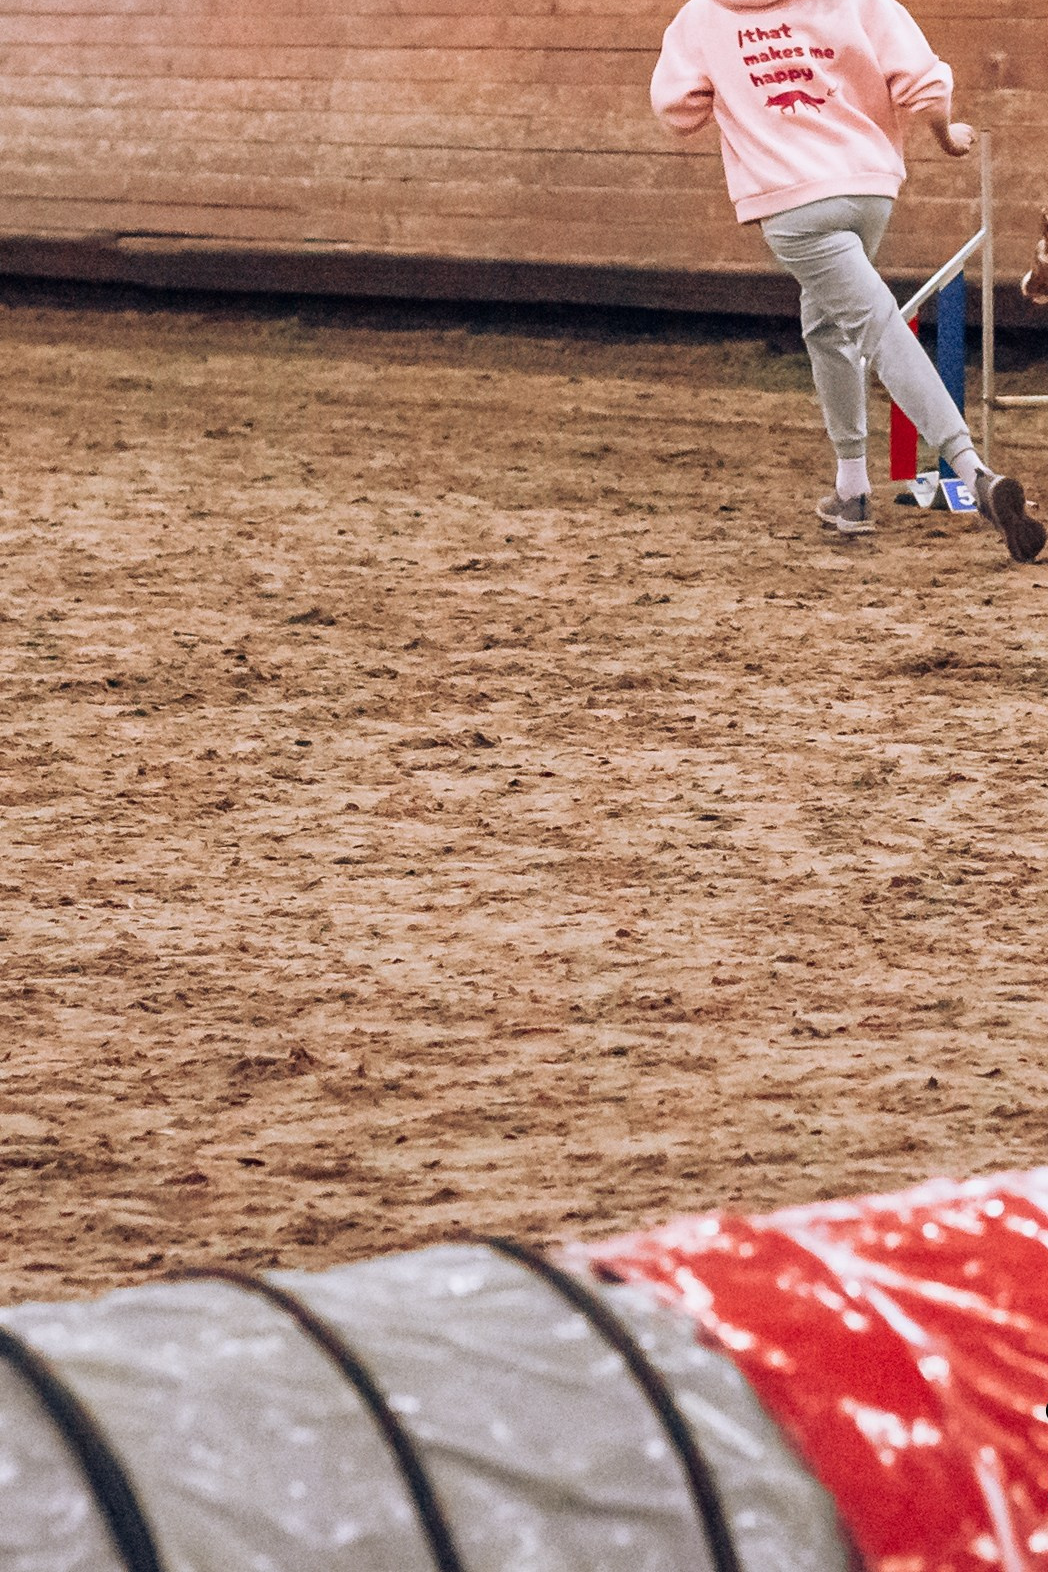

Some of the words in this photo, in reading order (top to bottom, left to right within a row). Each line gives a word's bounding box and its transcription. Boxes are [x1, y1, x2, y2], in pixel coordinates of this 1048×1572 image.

[743, 46, 804, 66] makes
[809, 47, 835, 59] me
[750, 68, 814, 87] happy
